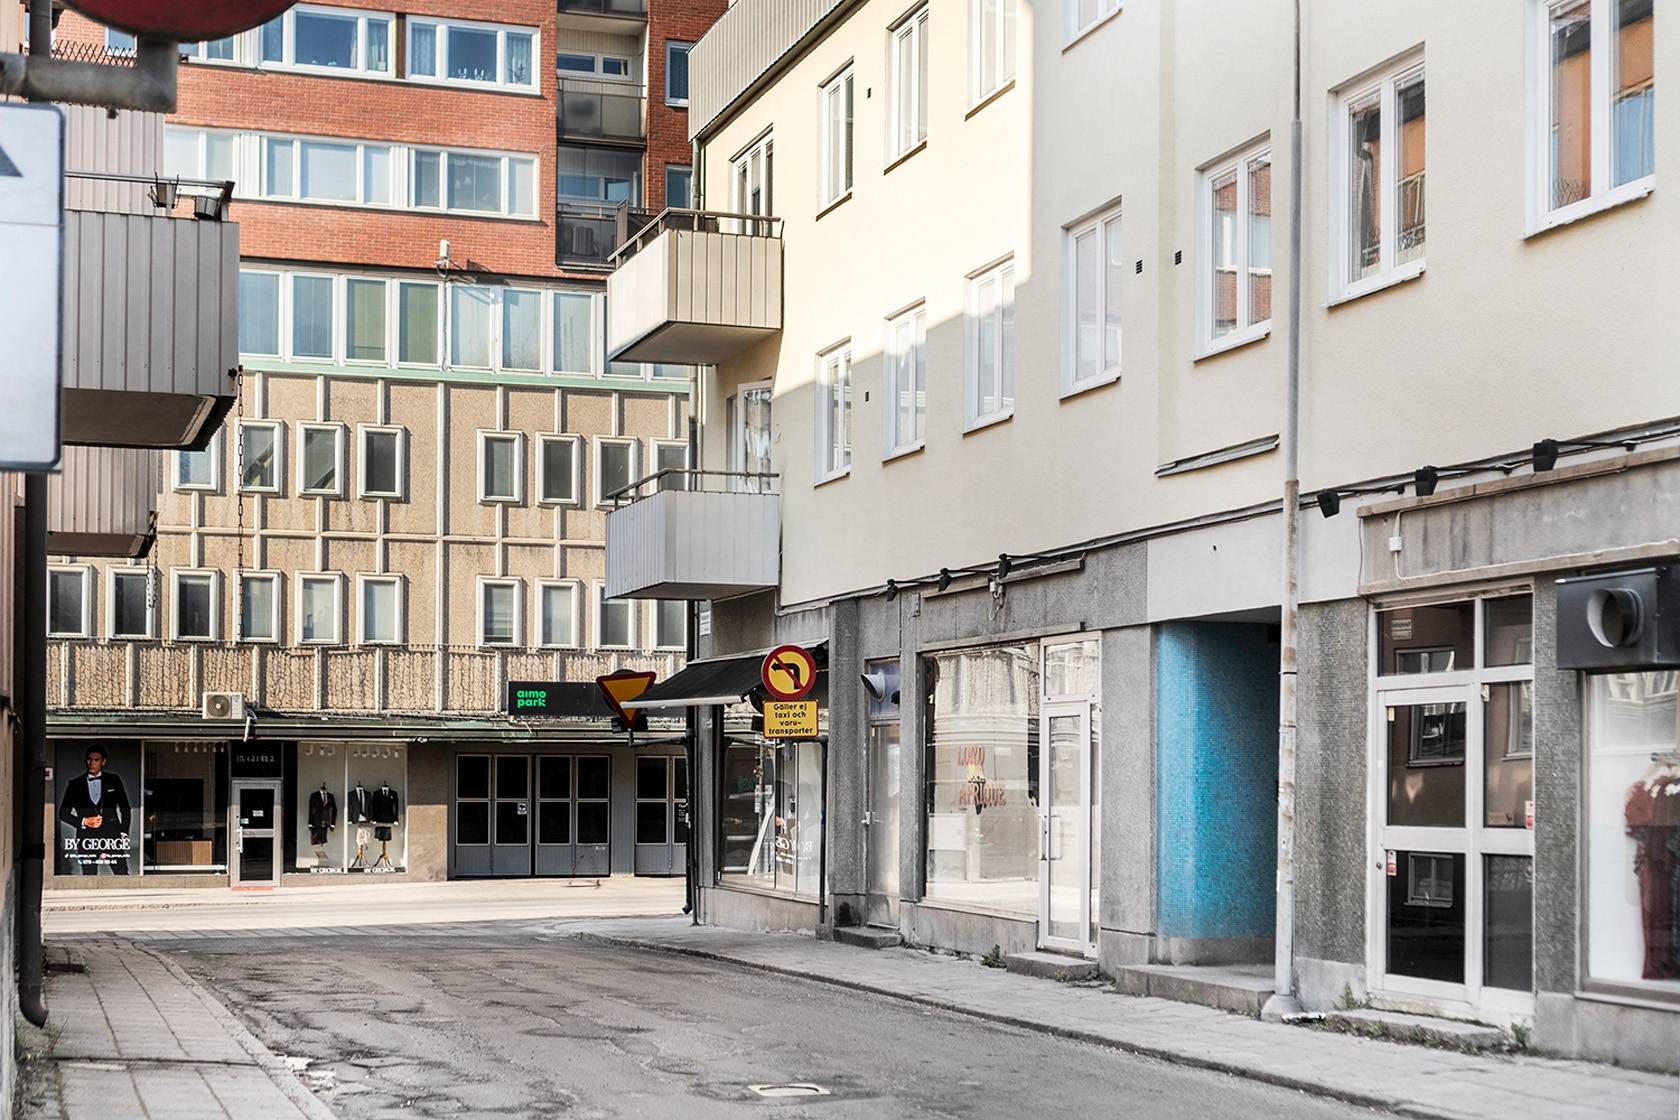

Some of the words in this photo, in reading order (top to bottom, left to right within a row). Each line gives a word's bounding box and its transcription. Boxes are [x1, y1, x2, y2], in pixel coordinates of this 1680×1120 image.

[517, 690, 547, 698] aimo
[517, 698, 546, 708] park
[773, 703, 797, 711] Gäller
[799, 703, 807, 711] ej
[768, 727, 813, 735] transporter
[64, 838, 80, 850] BY
[82, 838, 131, 850] GEORGE
